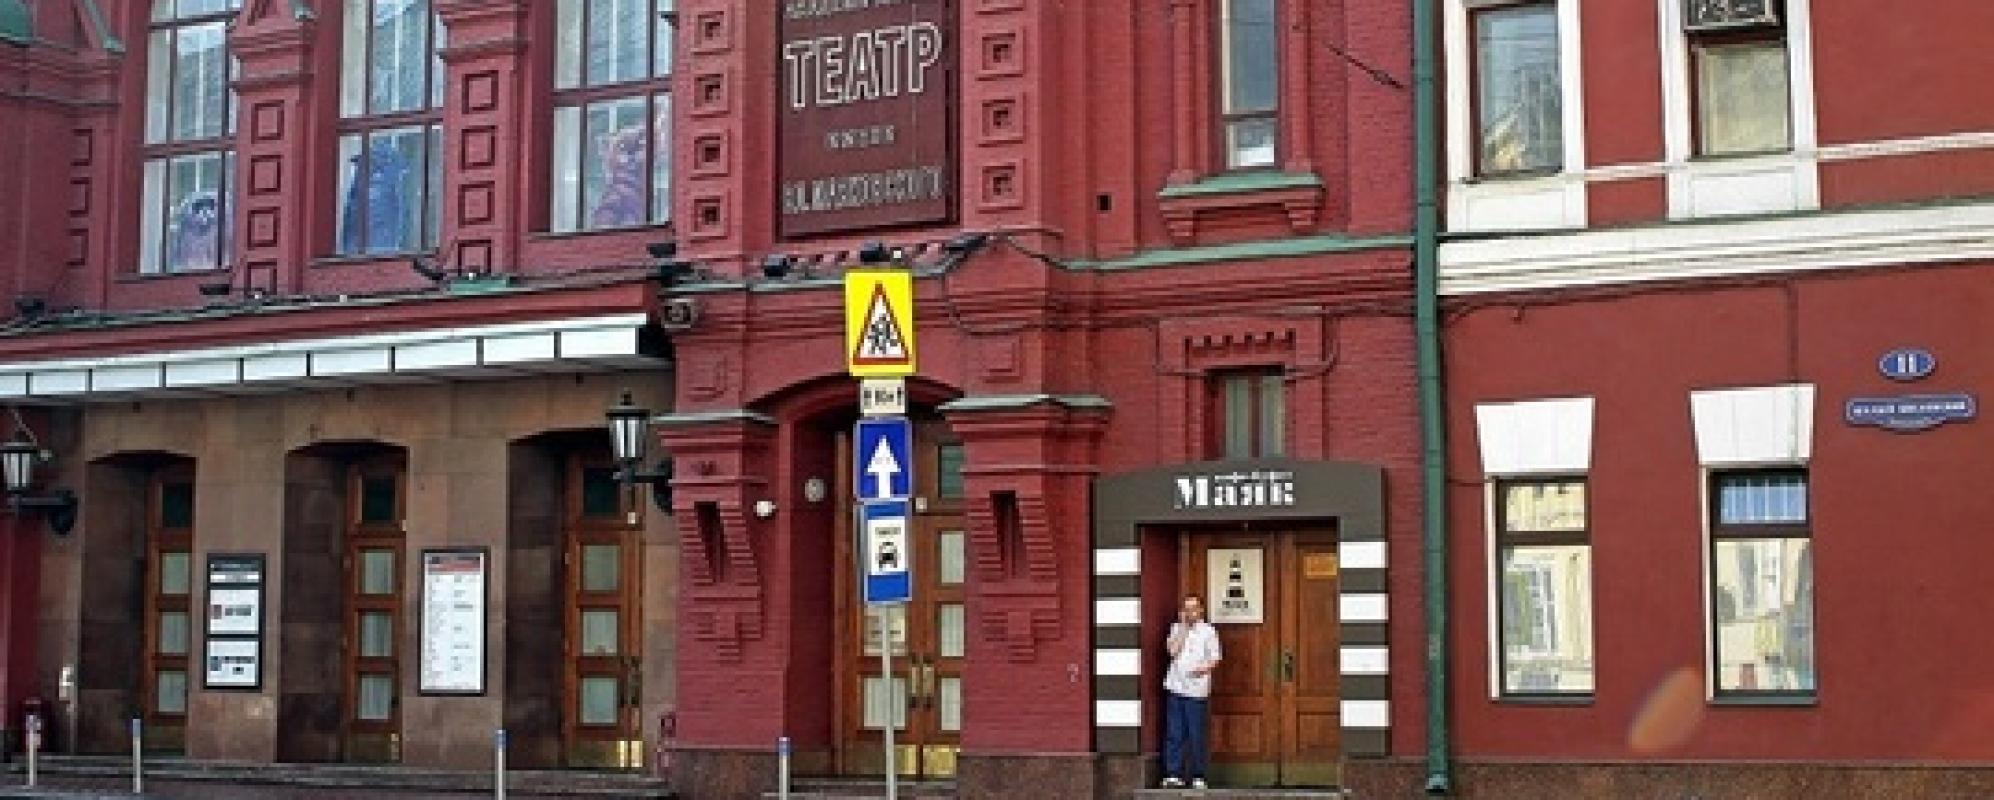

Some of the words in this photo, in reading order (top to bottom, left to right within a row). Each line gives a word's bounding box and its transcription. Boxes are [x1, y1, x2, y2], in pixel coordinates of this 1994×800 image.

[783, 22, 942, 108] ТЕАТР
[1897, 353, 1918, 373] 11
[1174, 477, 1295, 508] Маяк
